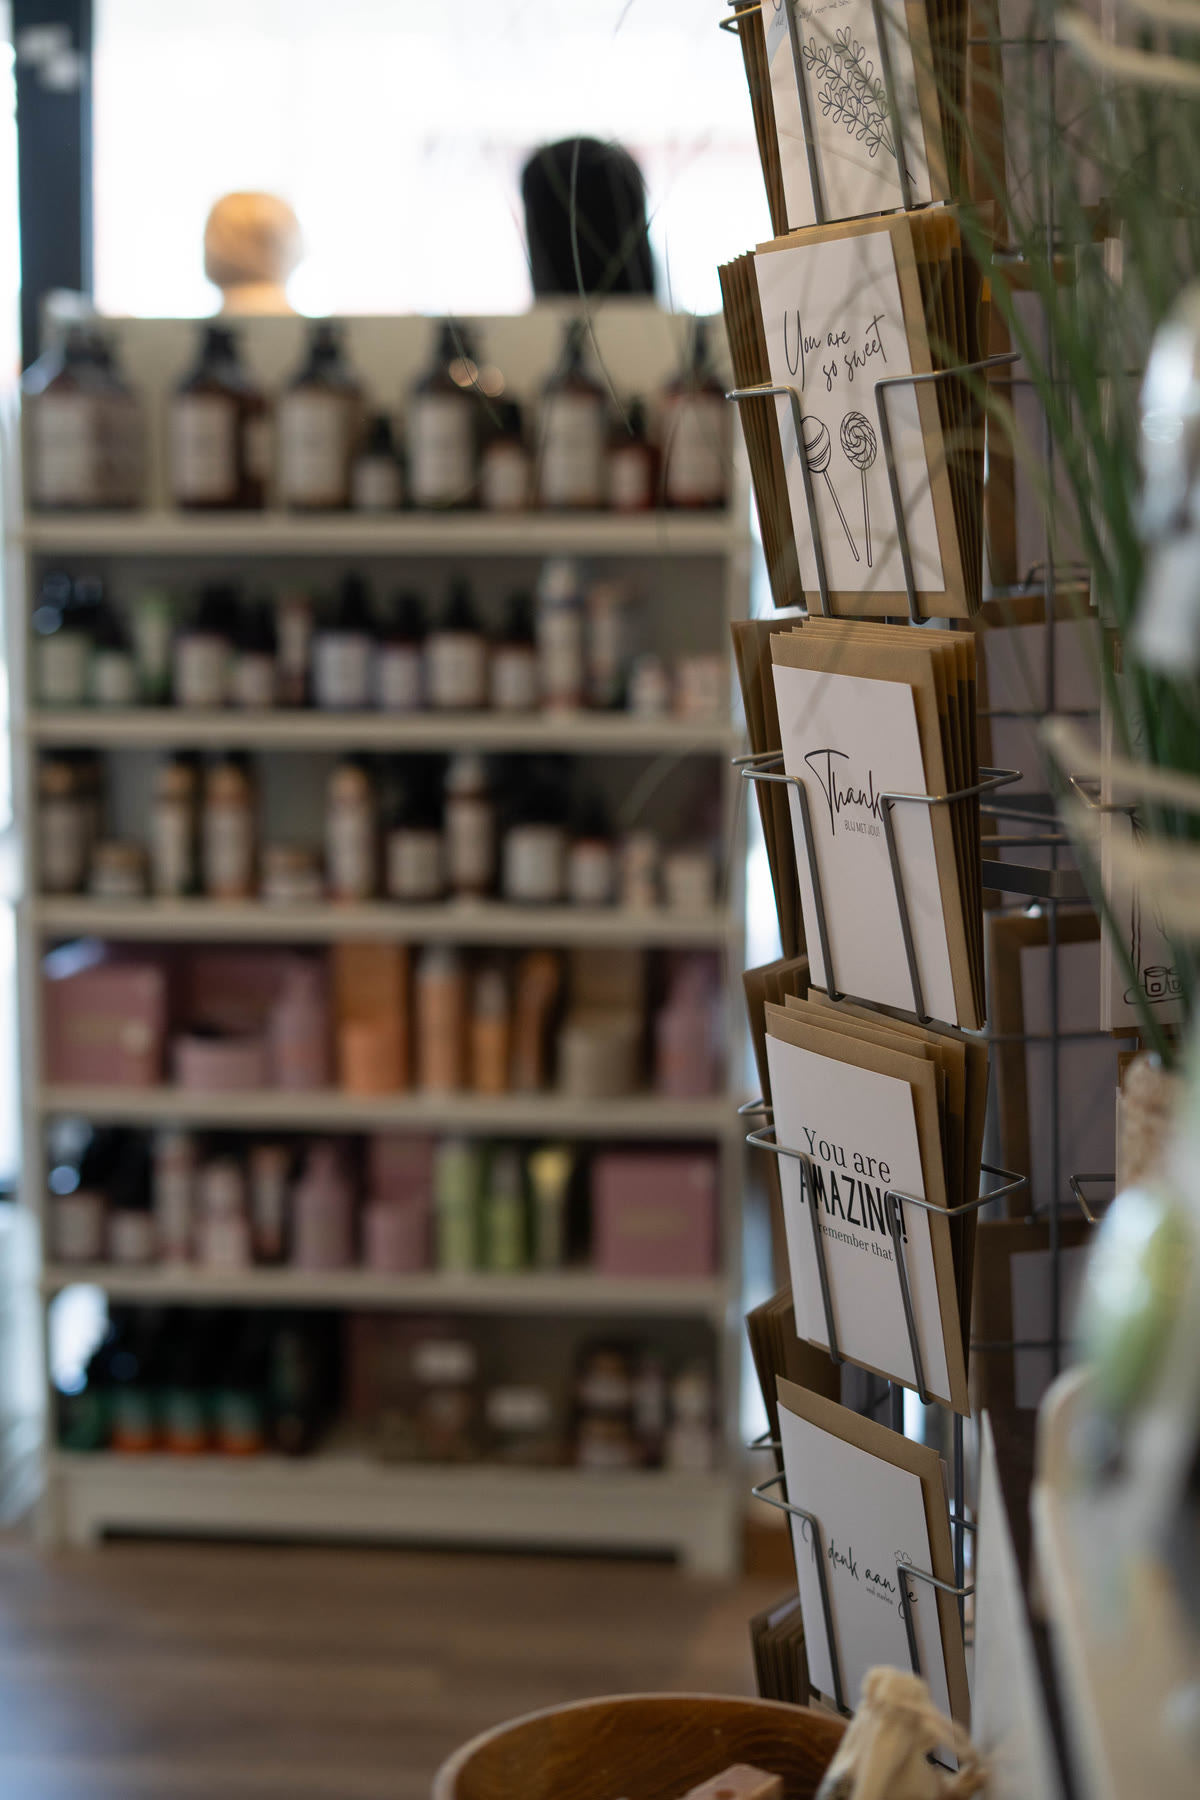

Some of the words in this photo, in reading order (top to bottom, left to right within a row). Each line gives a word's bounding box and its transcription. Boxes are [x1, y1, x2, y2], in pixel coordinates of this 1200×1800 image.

[784, 310, 821, 392] You
[827, 330, 851, 348] are
[822, 360, 838, 392] so
[844, 314, 888, 382] sweet
[804, 748, 895, 836] Thank
[802, 1126, 847, 1169] You
[853, 1152, 891, 1184] are
[818, 1223, 870, 1251] remember
[871, 1242, 893, 1262] that
[828, 1538, 859, 1580] denk
[865, 1568, 896, 1593] aan
